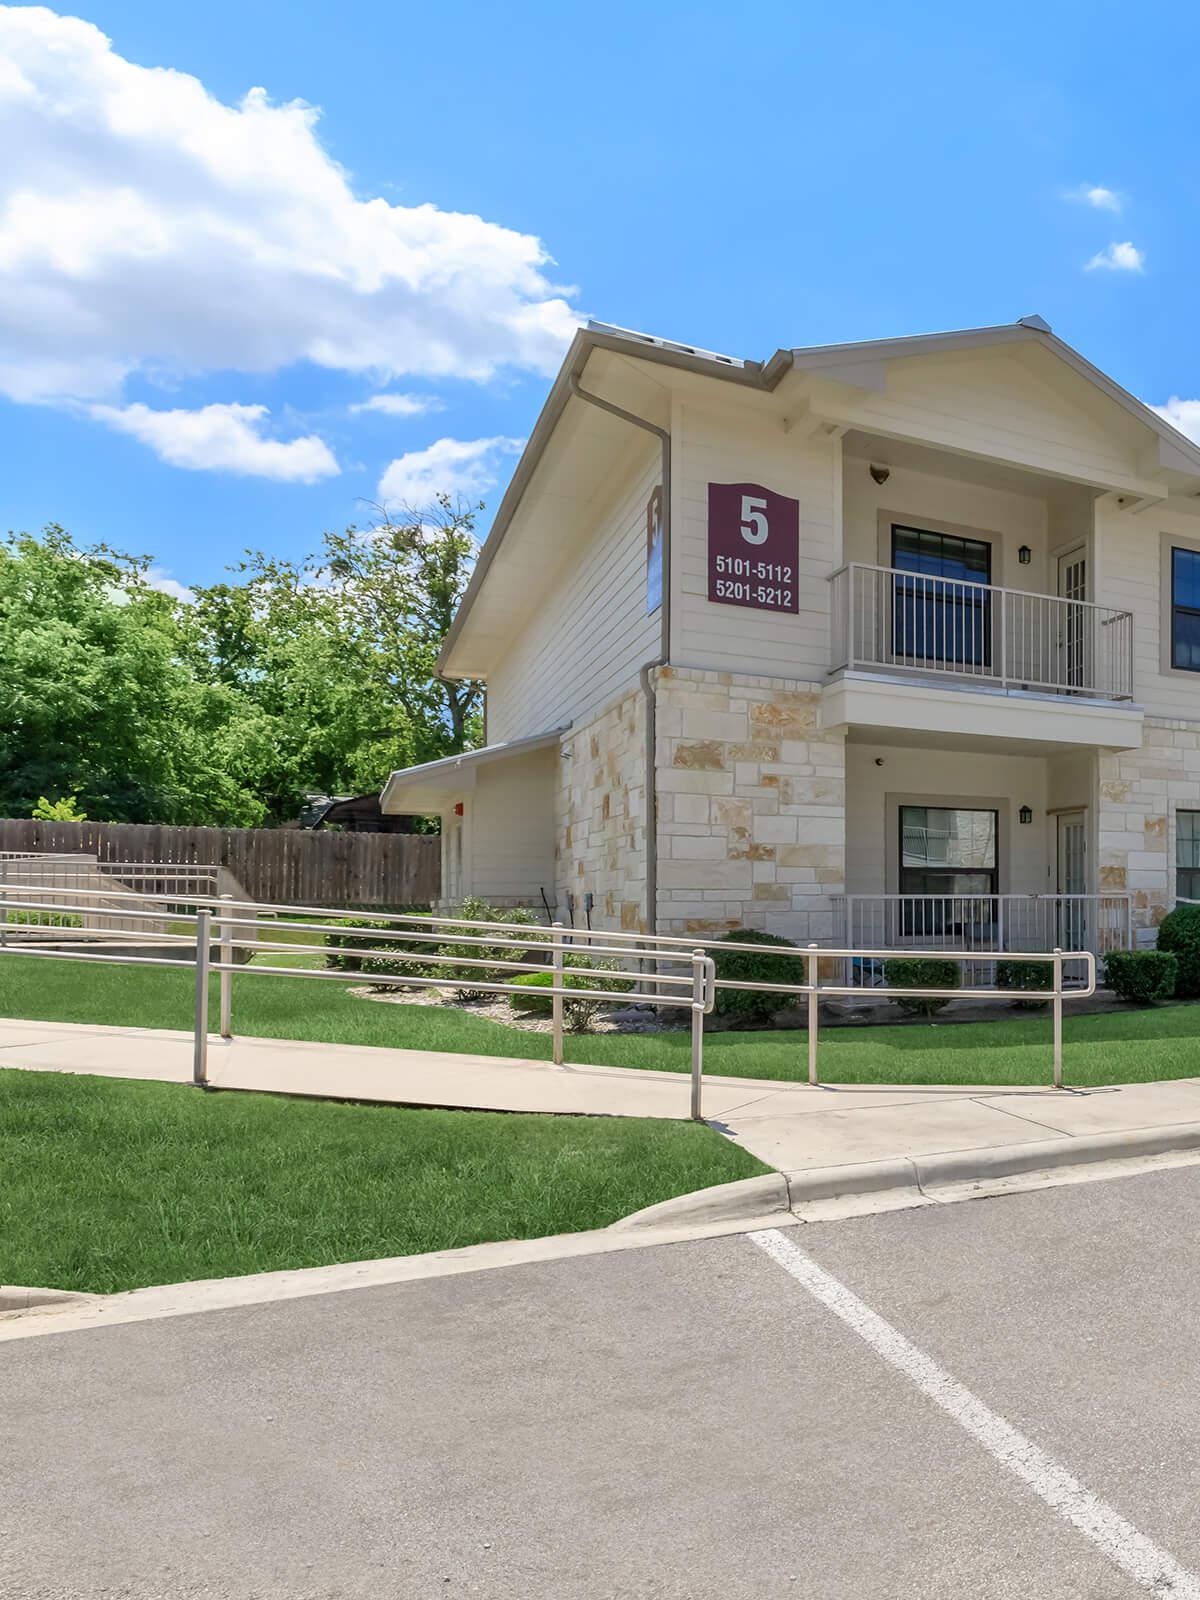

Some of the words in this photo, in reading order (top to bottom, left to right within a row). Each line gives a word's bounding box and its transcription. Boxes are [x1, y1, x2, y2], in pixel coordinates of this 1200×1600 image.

[740, 495, 769, 545] 5
[716, 555, 792, 583] 5101-5112
[716, 580, 792, 607] 5201-5212
